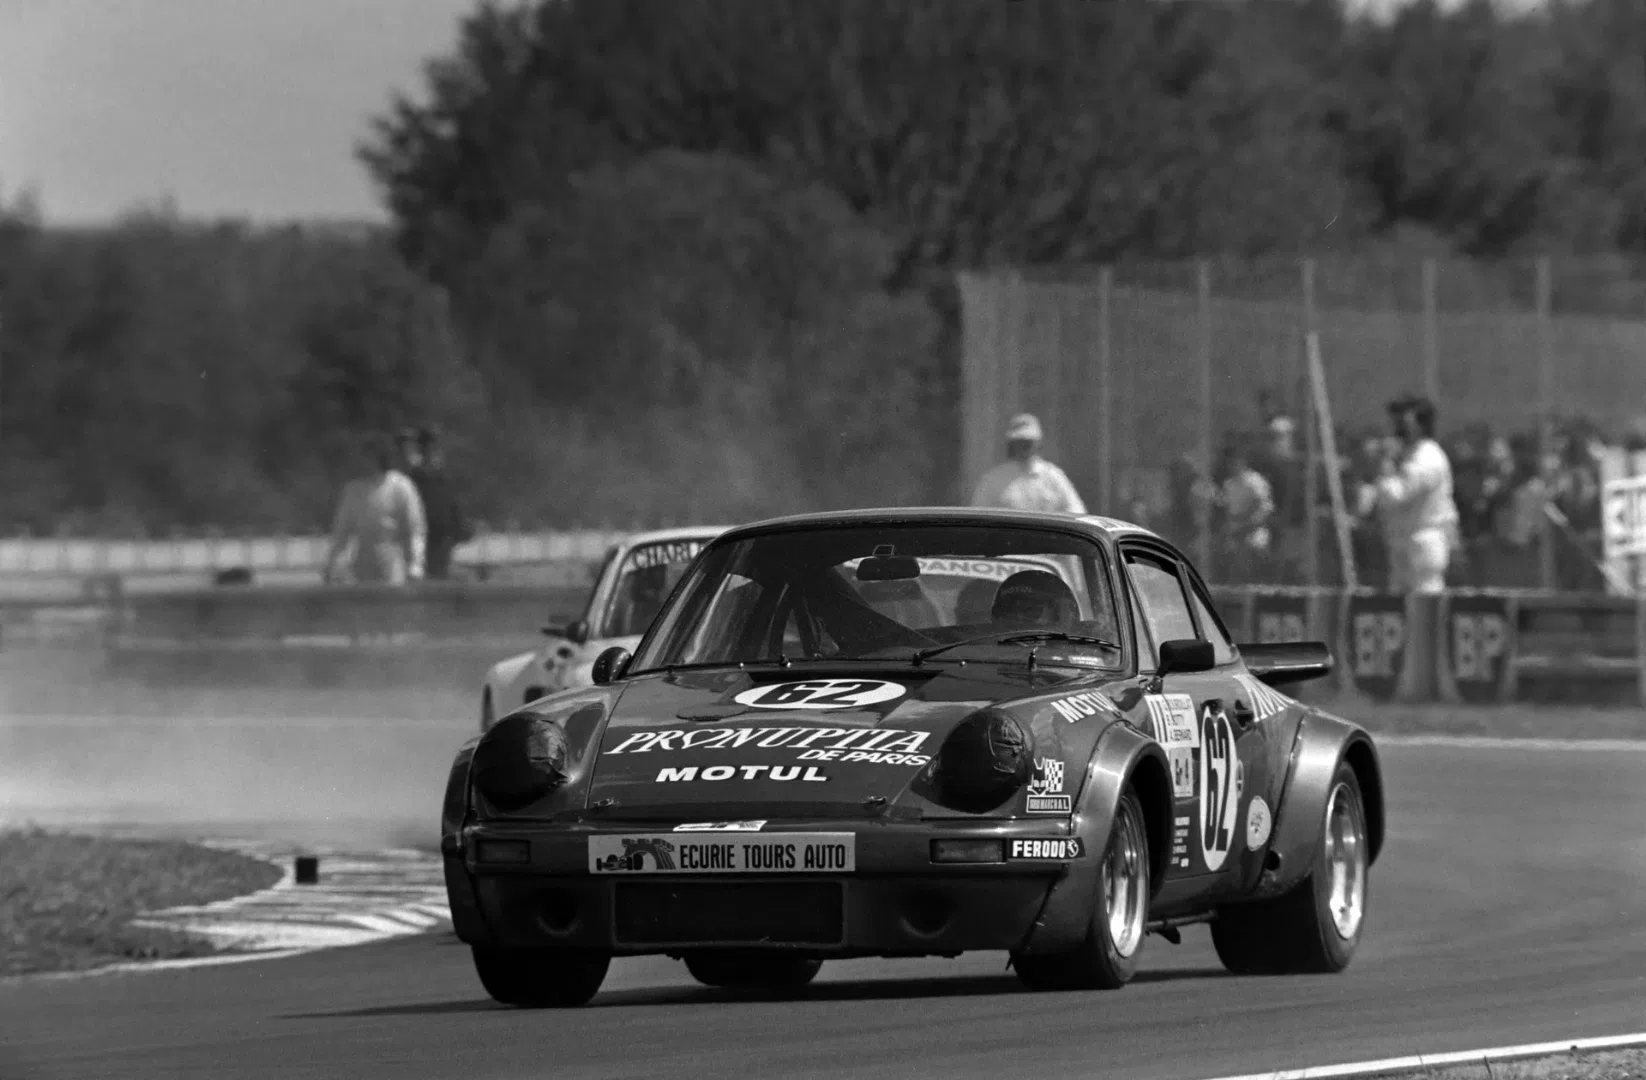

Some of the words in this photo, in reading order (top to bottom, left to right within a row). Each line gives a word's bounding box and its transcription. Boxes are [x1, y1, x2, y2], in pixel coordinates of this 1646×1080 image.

[752, 681, 887, 705] 62
[603, 727, 931, 755] PRONUPTIA
[796, 749, 846, 761] DE
[839, 751, 932, 766] PARIS
[655, 765, 828, 782] MOTUL
[1204, 716, 1231, 852] 62
[679, 844, 736, 870] ECURIE
[742, 844, 796, 869] TOURS
[803, 844, 846, 869] AUTO
[1012, 840, 1066, 858] FERODO
